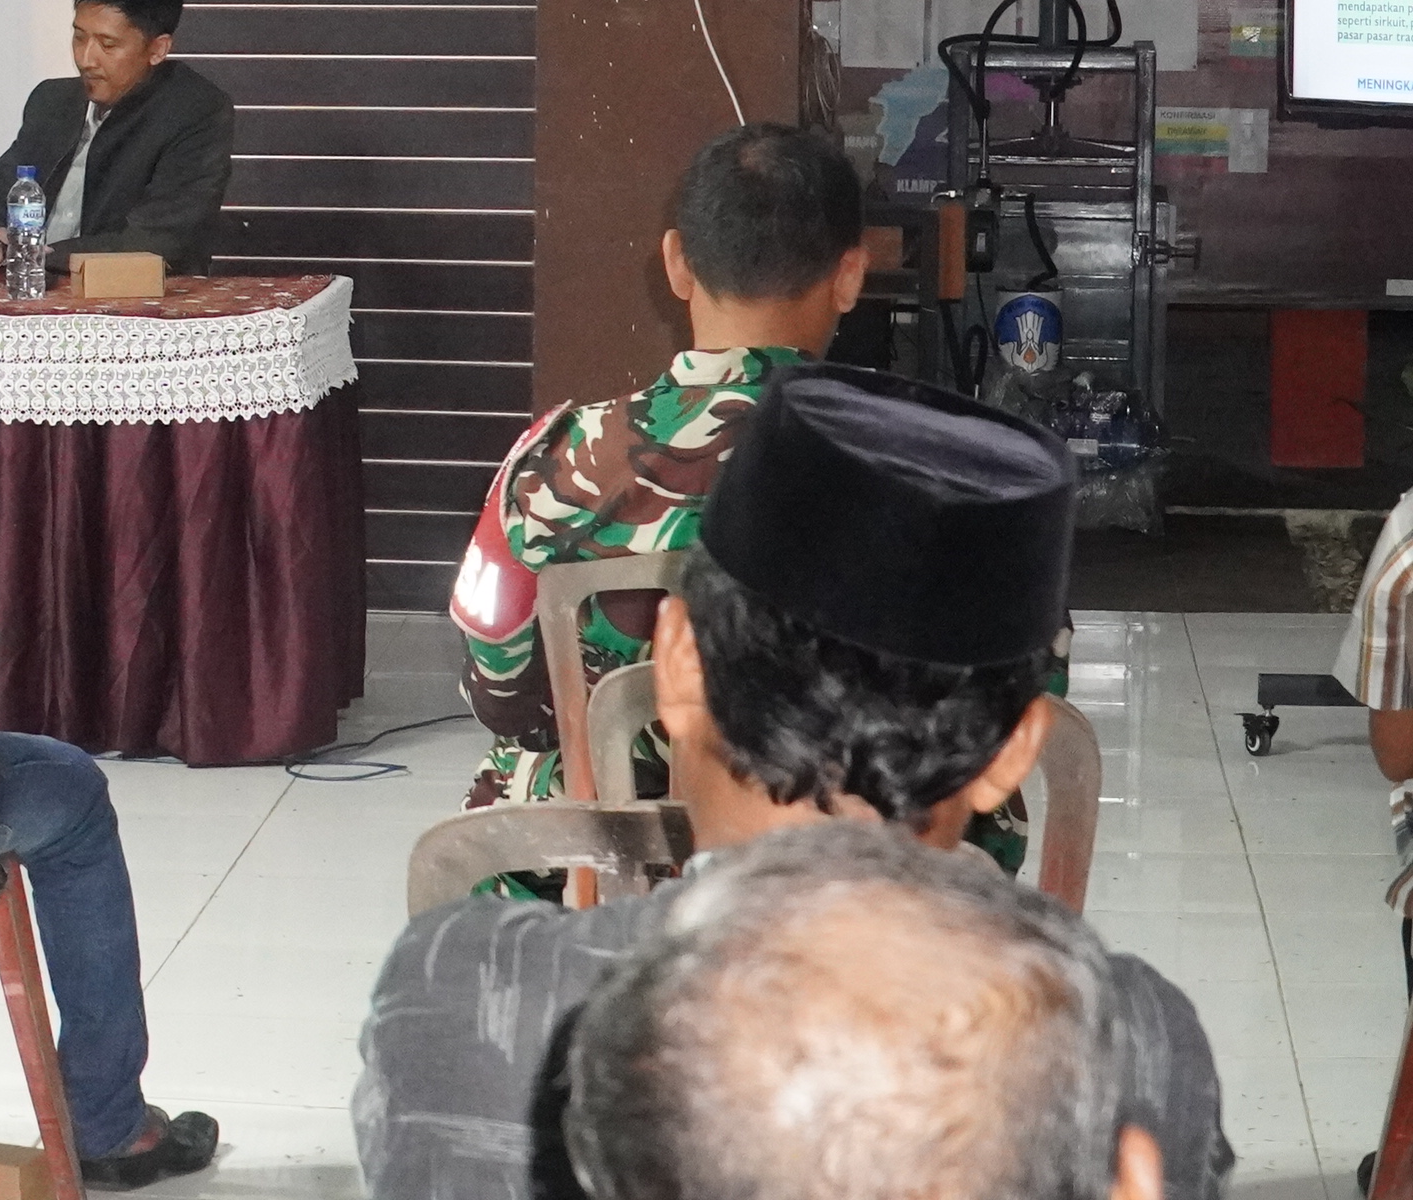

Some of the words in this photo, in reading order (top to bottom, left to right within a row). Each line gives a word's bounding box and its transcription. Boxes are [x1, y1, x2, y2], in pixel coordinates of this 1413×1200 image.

[1337, 1, 1405, 15] mendapatkan
[1337, 16, 1372, 29] seperti
[1374, 16, 1409, 29] sirkuit,
[1337, 31, 1363, 42] pasar
[1366, 32, 1393, 43] pasar
[1357, 78, 1413, 91] MENINGK
